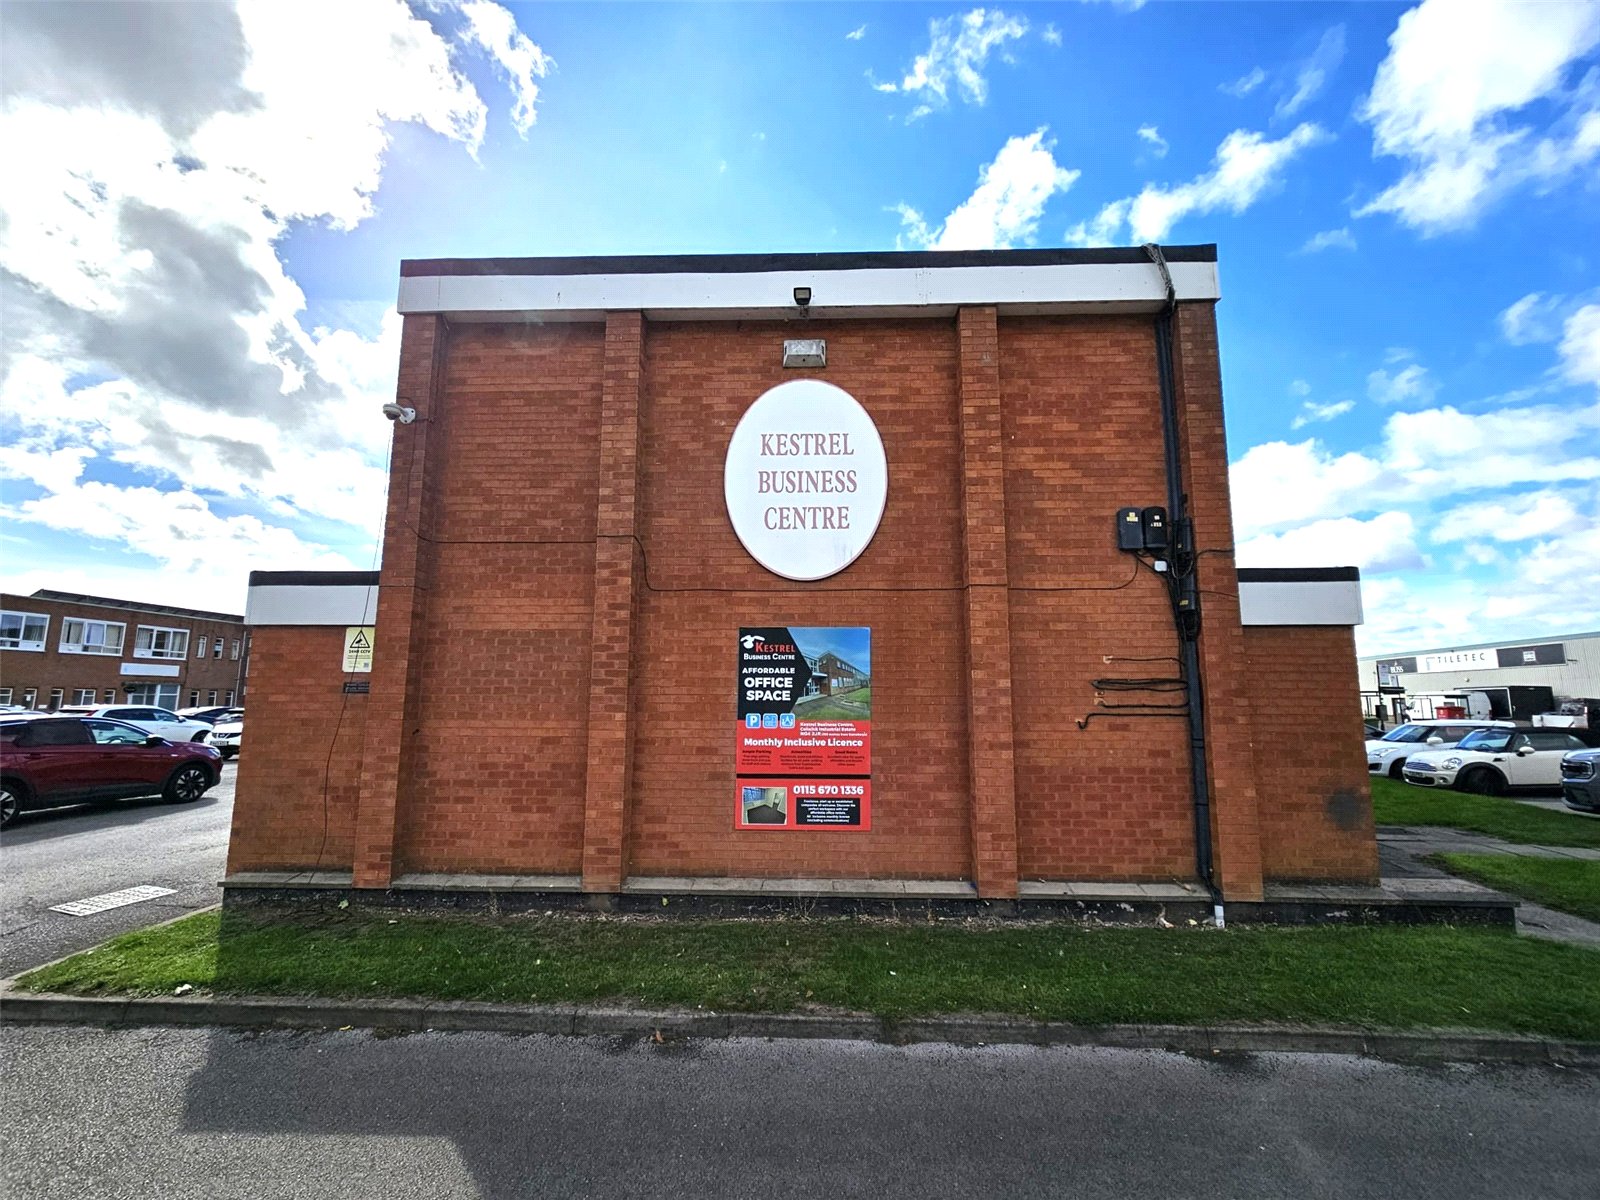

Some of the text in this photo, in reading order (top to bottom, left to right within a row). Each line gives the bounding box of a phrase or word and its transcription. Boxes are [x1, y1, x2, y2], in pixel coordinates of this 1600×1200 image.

[760, 433, 854, 456] KESTREL
[758, 470, 857, 493] BUSINESS
[764, 506, 850, 530] CENTRE
[755, 642, 795, 652] KESTREL
[1437, 652, 1486, 664] TILETEC
[744, 677, 793, 688] OFFICE
[746, 690, 791, 701] SPACE
[744, 737, 864, 748] Monthly Inclusive Licence
[793, 785, 864, 795] 0115 670 1336
